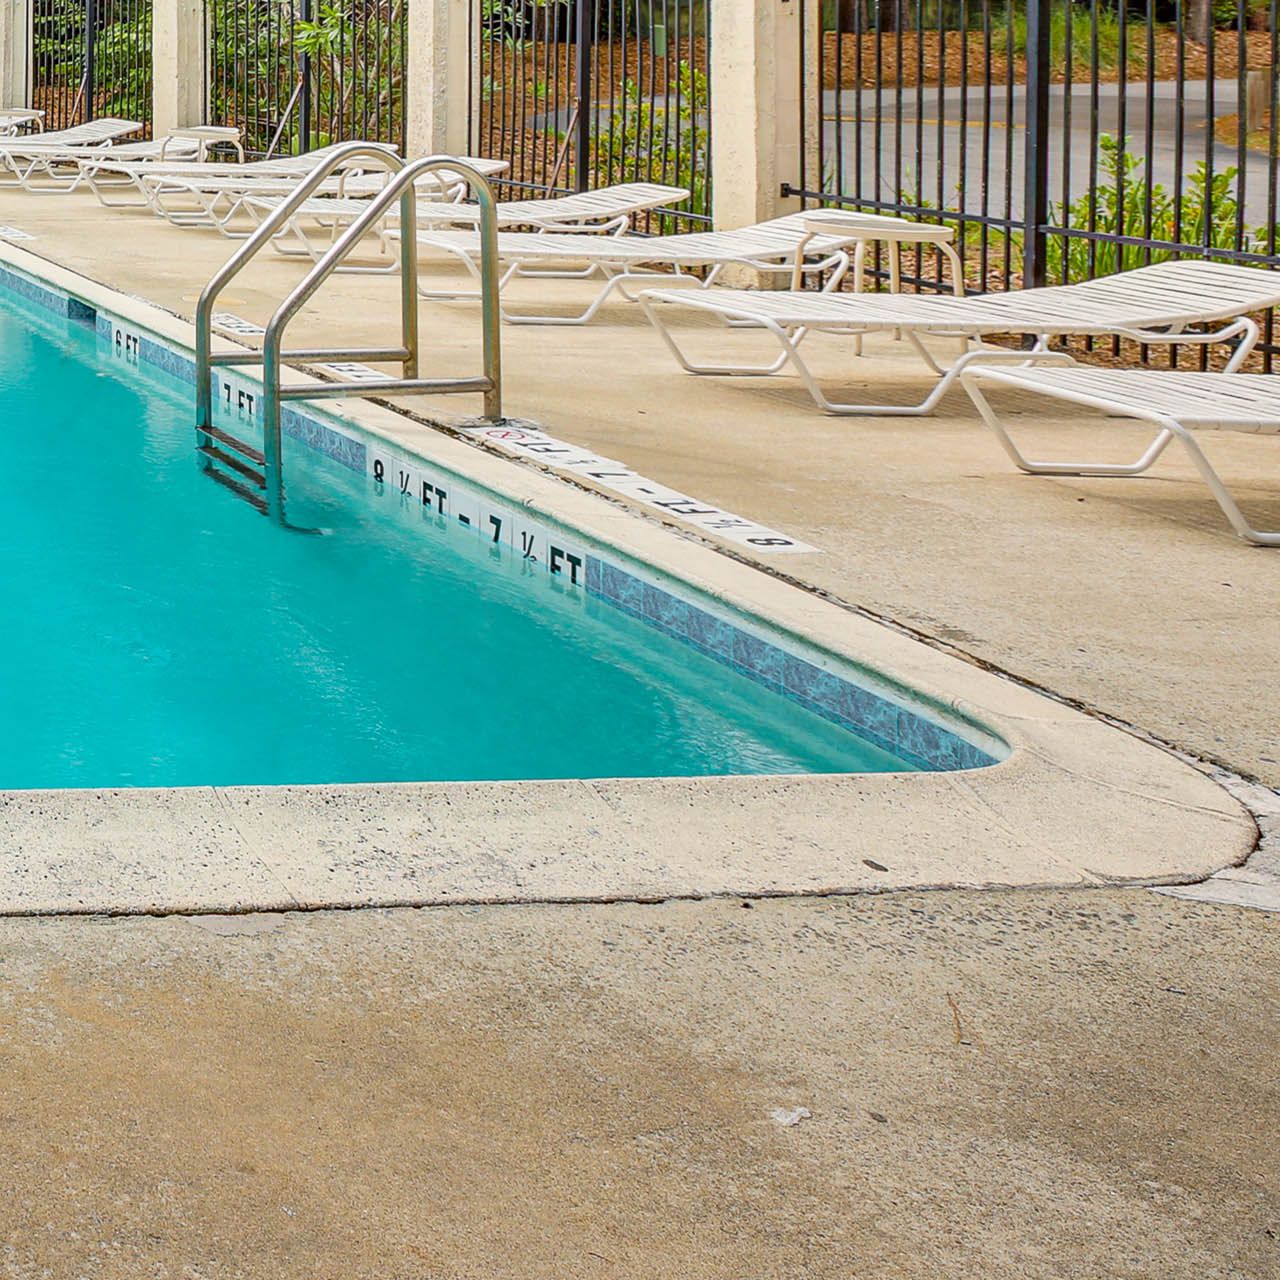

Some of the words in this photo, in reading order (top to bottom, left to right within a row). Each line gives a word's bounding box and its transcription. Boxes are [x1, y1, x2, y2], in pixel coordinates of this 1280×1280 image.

[125, 334, 139, 355] FT
[223, 383, 231, 404] 7
[237, 390, 254, 415] FT
[653, 498, 718, 515] FT
[373, 459, 384, 483] 8
[422, 480, 447, 515] FT
[489, 515, 502, 543] 7
[550, 545, 582, 586] FT
